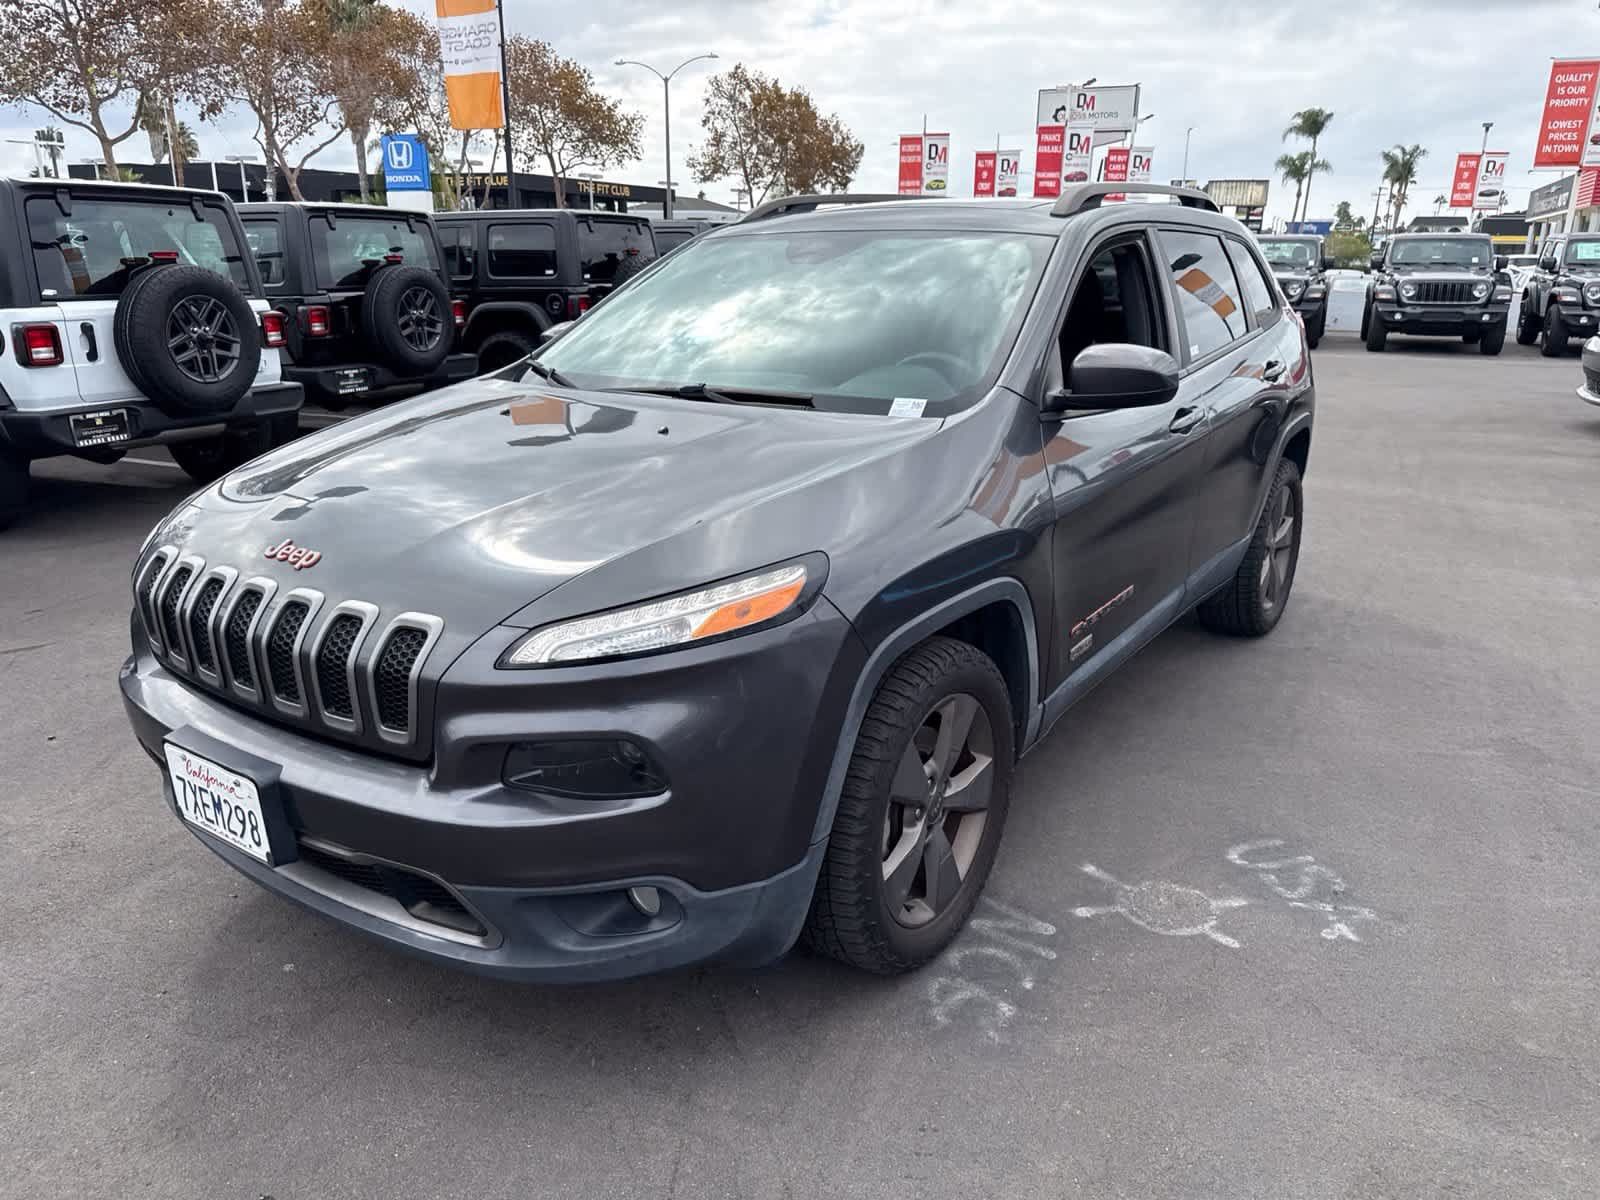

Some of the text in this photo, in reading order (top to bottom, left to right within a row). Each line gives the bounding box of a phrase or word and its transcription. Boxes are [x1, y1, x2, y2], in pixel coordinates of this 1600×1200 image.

[1555, 73, 1593, 83] QUALITY
[1557, 86, 1586, 95] IS OUR
[1550, 97, 1590, 107] PRIORITY
[1088, 111, 1119, 120] MOTORS
[1548, 120, 1583, 129] LOWEST
[1548, 132, 1578, 141] PRICES
[1542, 144, 1579, 153] IN TOWN
[386, 175, 422, 183] HONDA
[597, 183, 609, 195] FIT
[611, 185, 630, 197] CLUB
[264, 539, 321, 571] Jeep
[185, 759, 240, 797] California
[176, 775, 262, 847] 7XEM298
